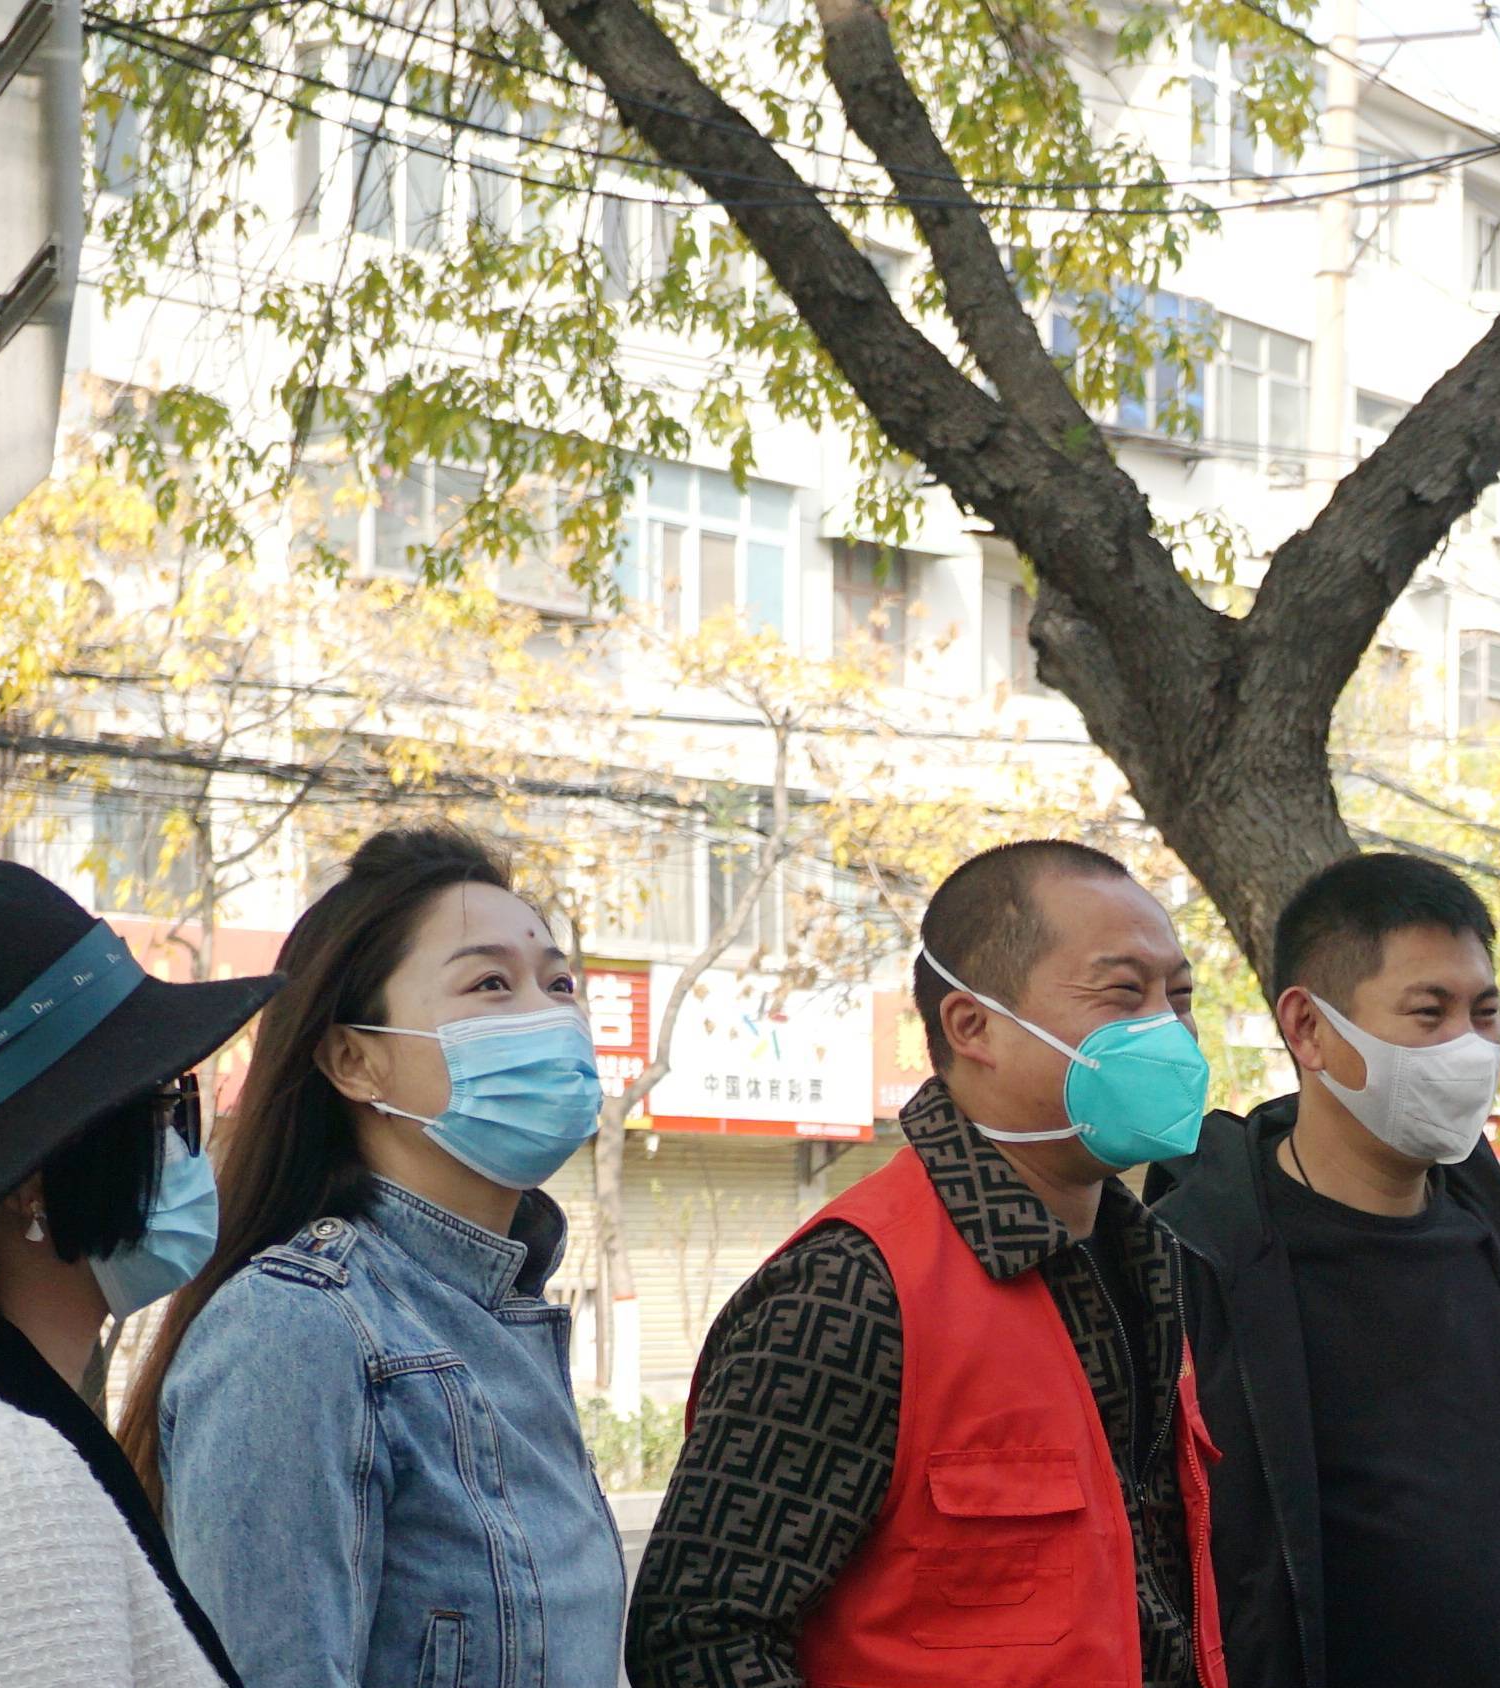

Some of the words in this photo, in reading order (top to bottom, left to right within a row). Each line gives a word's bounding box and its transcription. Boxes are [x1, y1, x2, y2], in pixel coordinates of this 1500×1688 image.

[704, 1073, 824, 1105] 中国体育彩票
